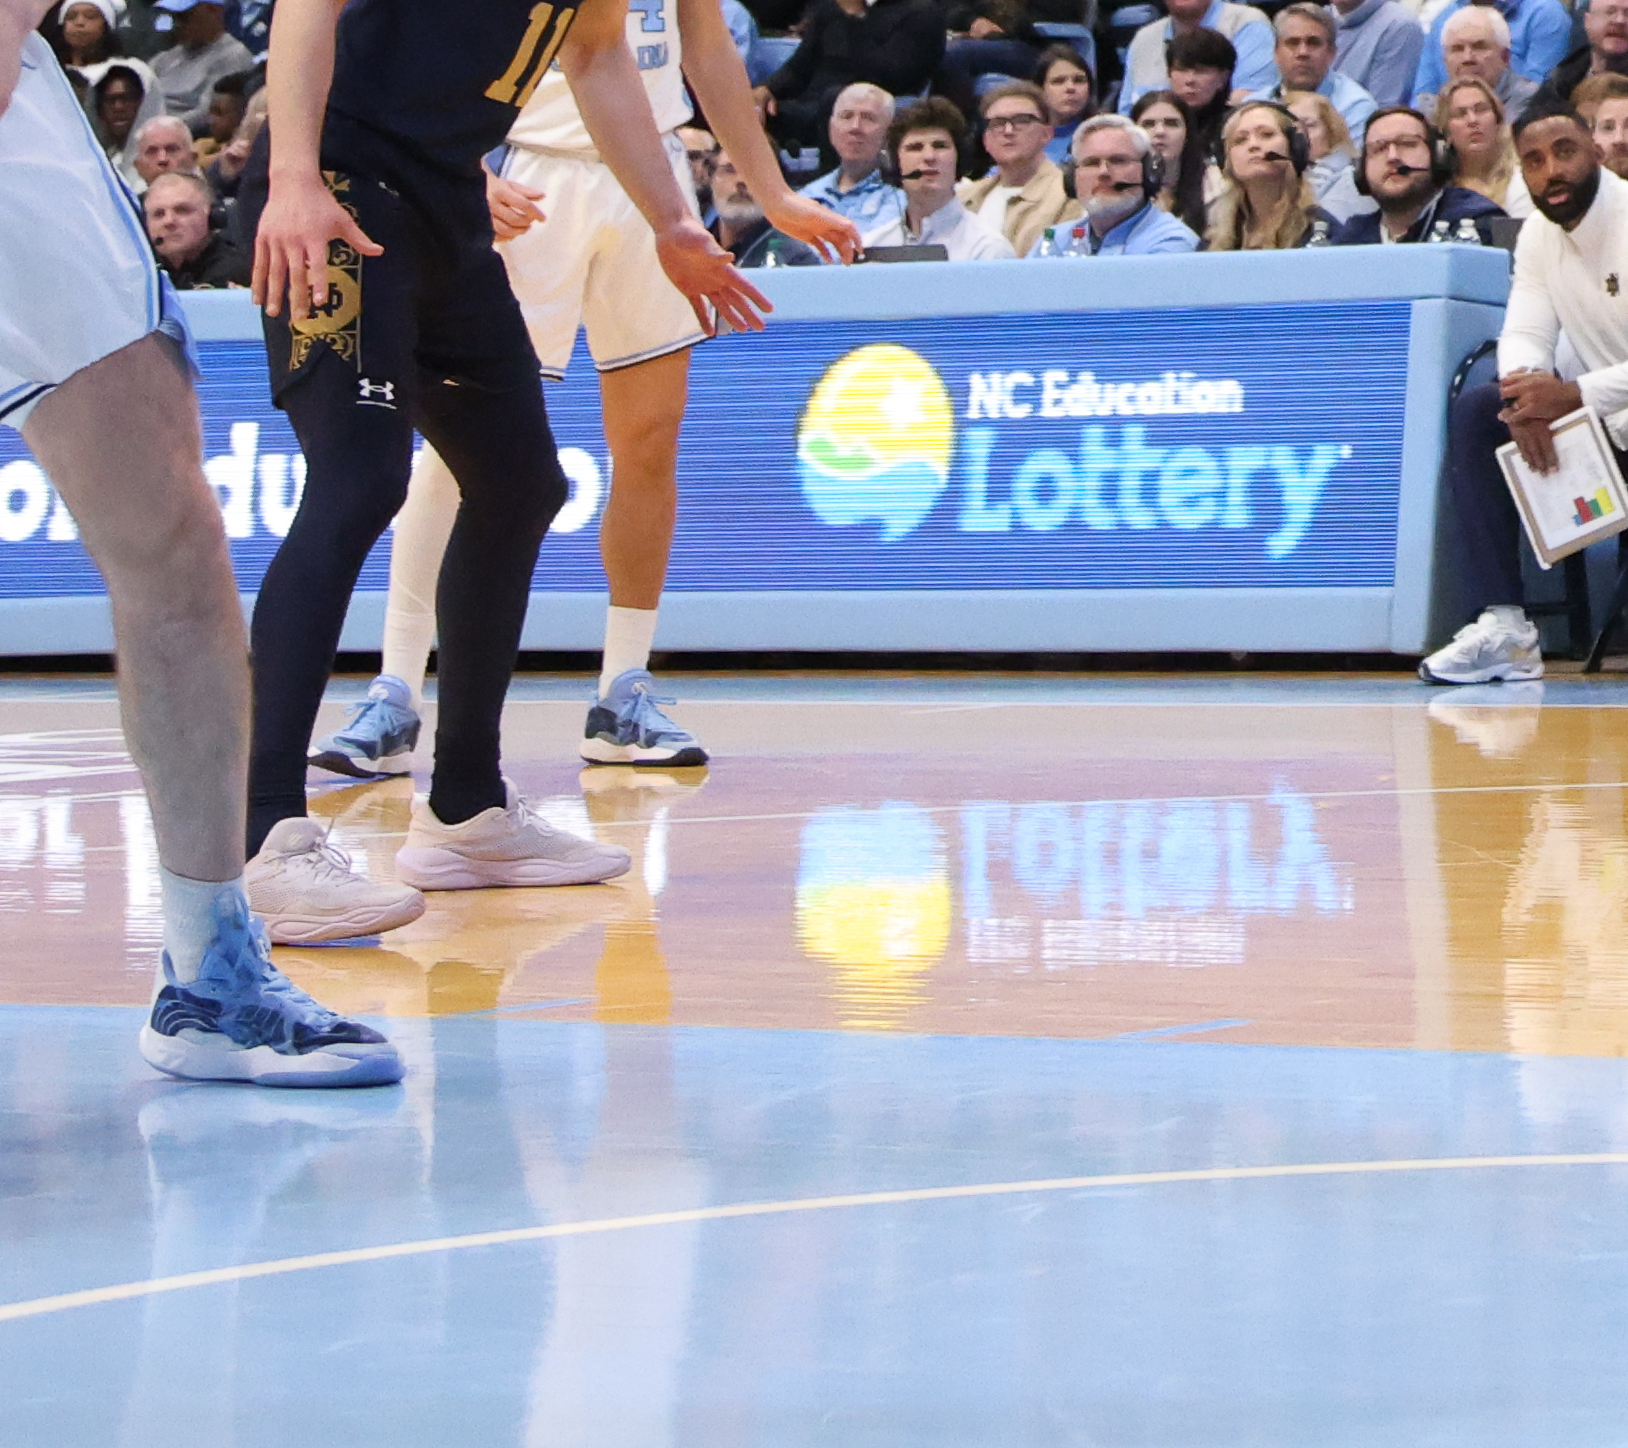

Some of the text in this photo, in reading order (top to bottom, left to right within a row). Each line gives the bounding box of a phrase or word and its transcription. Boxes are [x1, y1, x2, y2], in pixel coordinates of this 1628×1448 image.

[966, 370, 1243, 419] NC Education
[957, 424, 1340, 559] Lottery
